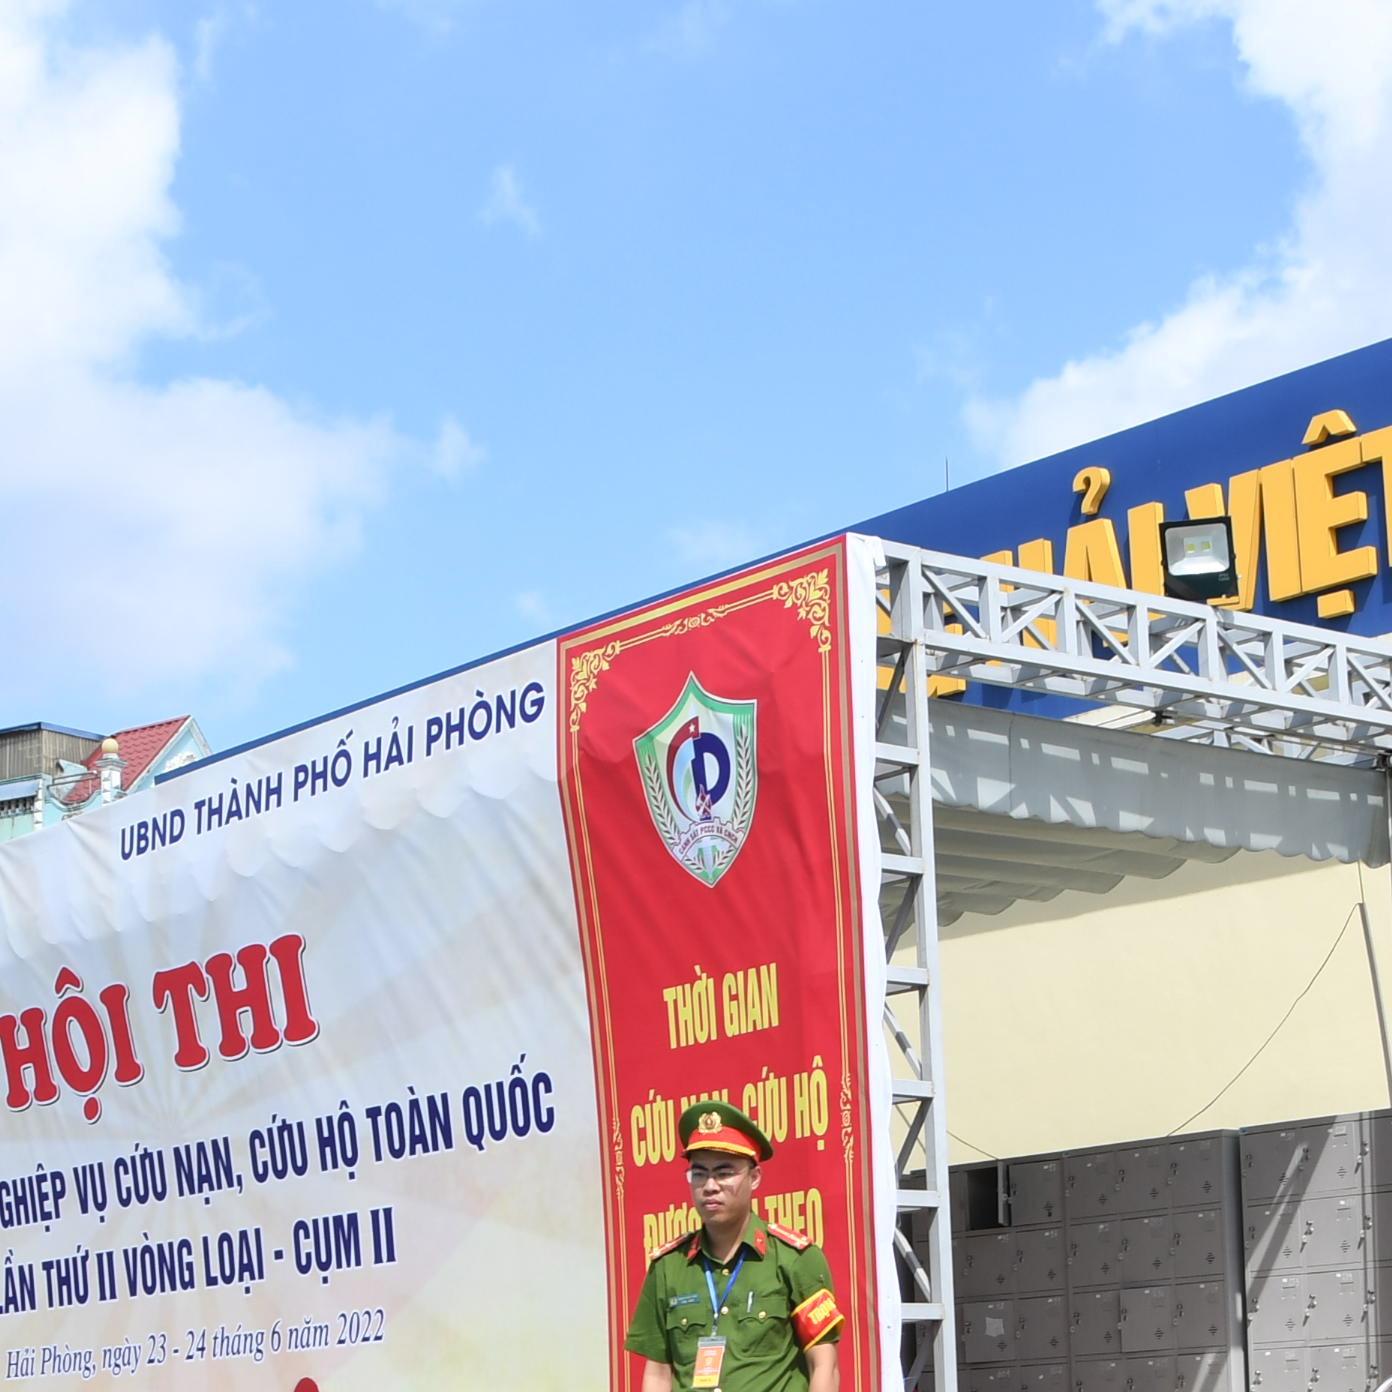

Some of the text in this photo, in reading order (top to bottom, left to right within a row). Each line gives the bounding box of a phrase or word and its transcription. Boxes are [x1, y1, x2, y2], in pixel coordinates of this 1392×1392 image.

[121, 681, 545, 860] UBND THÀNH PHỐ HẢI PHÒNG
[153, 934, 318, 1069] THI
[663, 962, 780, 1049] THỜI GIAN
[73, 1162, 107, 1223] VỤ
[114, 1143, 168, 1208] CỨU
[173, 1137, 243, 1205] NẠN,
[249, 1114, 308, 1183] CỨU
[315, 1100, 358, 1180] HỘ
[365, 1086, 454, 1162] TOÀN
[462, 1053, 554, 1151] QUỐC
[630, 1088, 676, 1167] CỨU
[794, 1055, 830, 1151] HỘ
[42, 1245, 89, 1308] THỨ
[96, 1250, 118, 1301] II
[122, 1232, 195, 1297] VÒNG
[202, 1227, 265, 1294] LOẠI
[273, 1249, 284, 1261] -
[293, 1212, 362, 1284] CỤM
[370, 1206, 397, 1265] II
[6, 1345, 35, 1379] Hải
[41, 1342, 97, 1380] Phòng,
[102, 1337, 142, 1375] ngày
[147, 1333, 167, 1364] 23
[185, 1328, 206, 1361] 24
[212, 1325, 265, 1362] tháng
[271, 1320, 282, 1352] 6
[288, 1316, 329, 1350] năm
[336, 1309, 385, 1346] 2022
